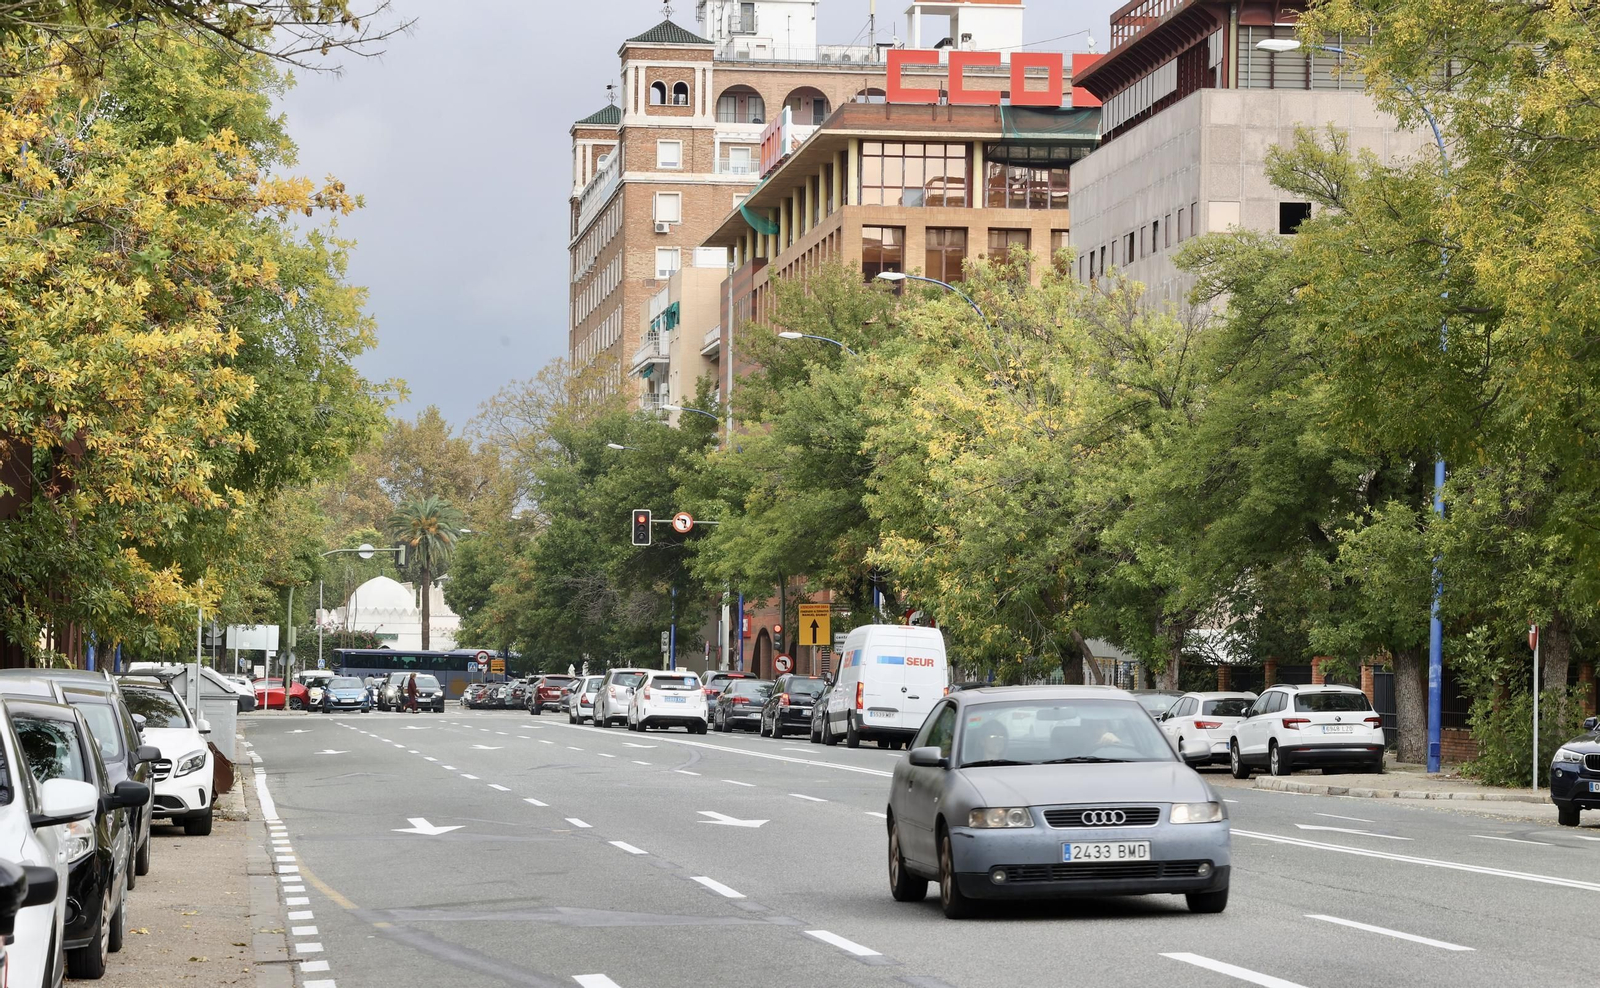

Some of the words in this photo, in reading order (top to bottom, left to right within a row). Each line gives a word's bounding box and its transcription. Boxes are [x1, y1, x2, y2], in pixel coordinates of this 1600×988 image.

[906, 656, 935, 668] SEUR
[1073, 845, 1111, 859] 2433
[1118, 844, 1146, 859] BMD
